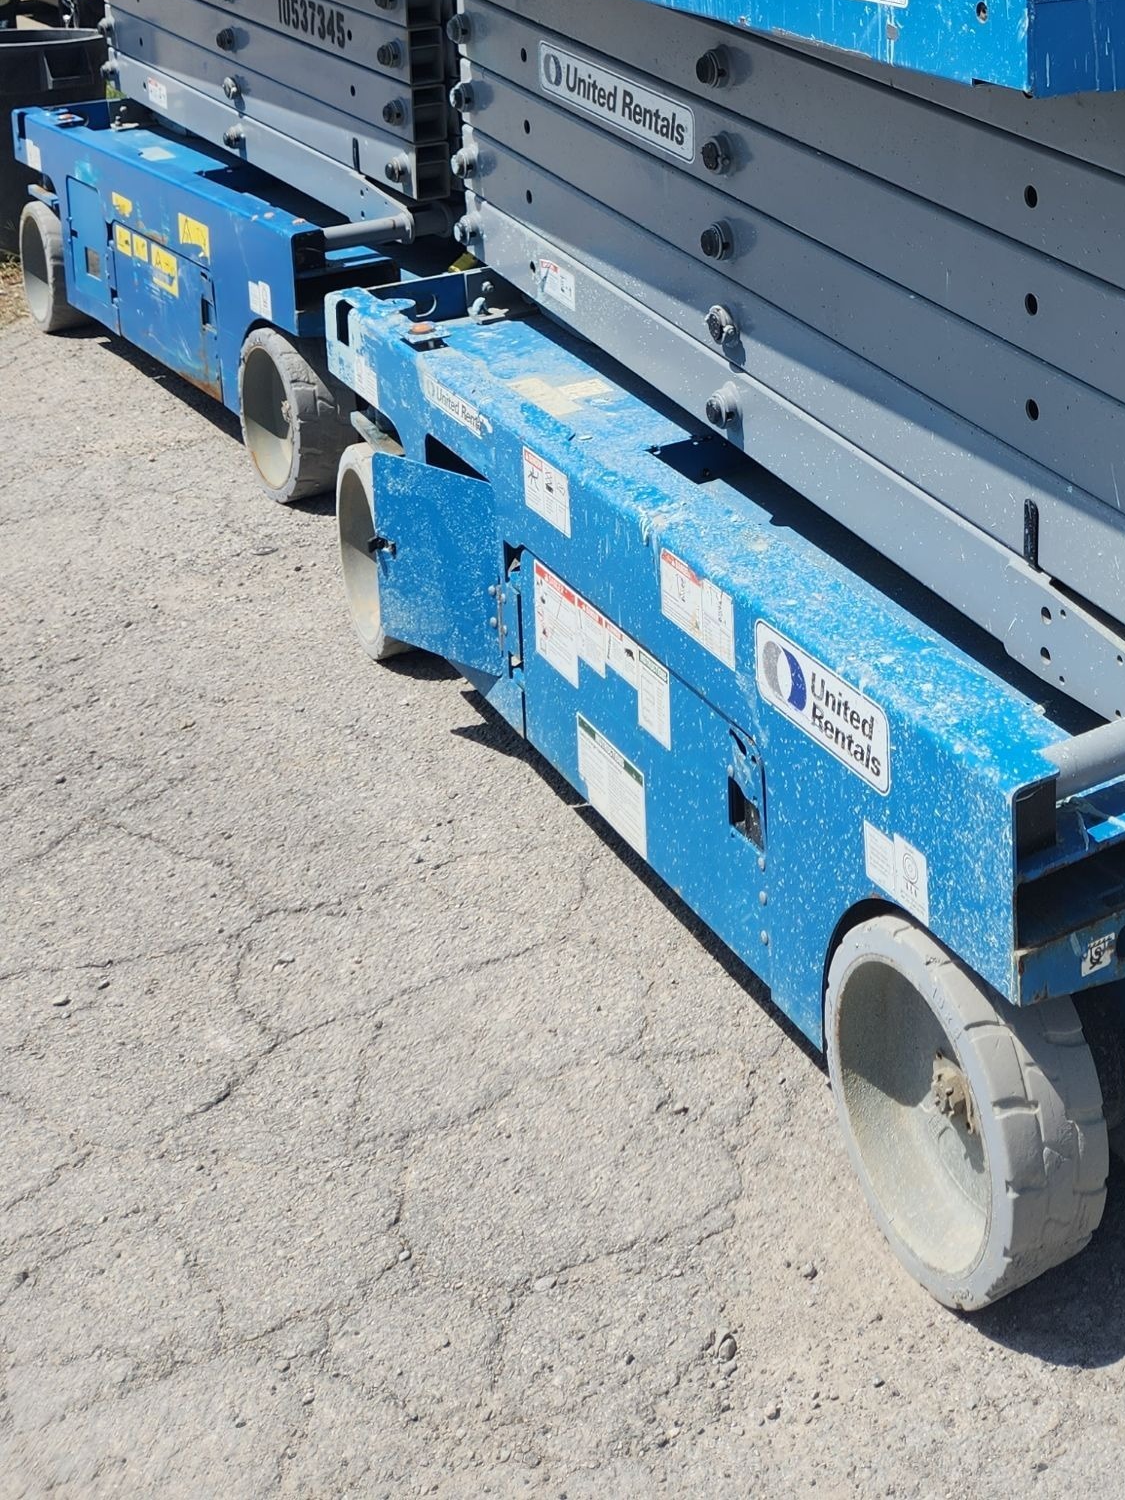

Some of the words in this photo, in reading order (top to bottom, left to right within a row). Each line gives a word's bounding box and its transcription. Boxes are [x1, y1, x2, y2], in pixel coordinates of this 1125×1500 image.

[566, 64, 618, 113] United
[622, 90, 685, 146] Rentals
[810, 671, 875, 741] United
[811, 702, 882, 778] Rentals
